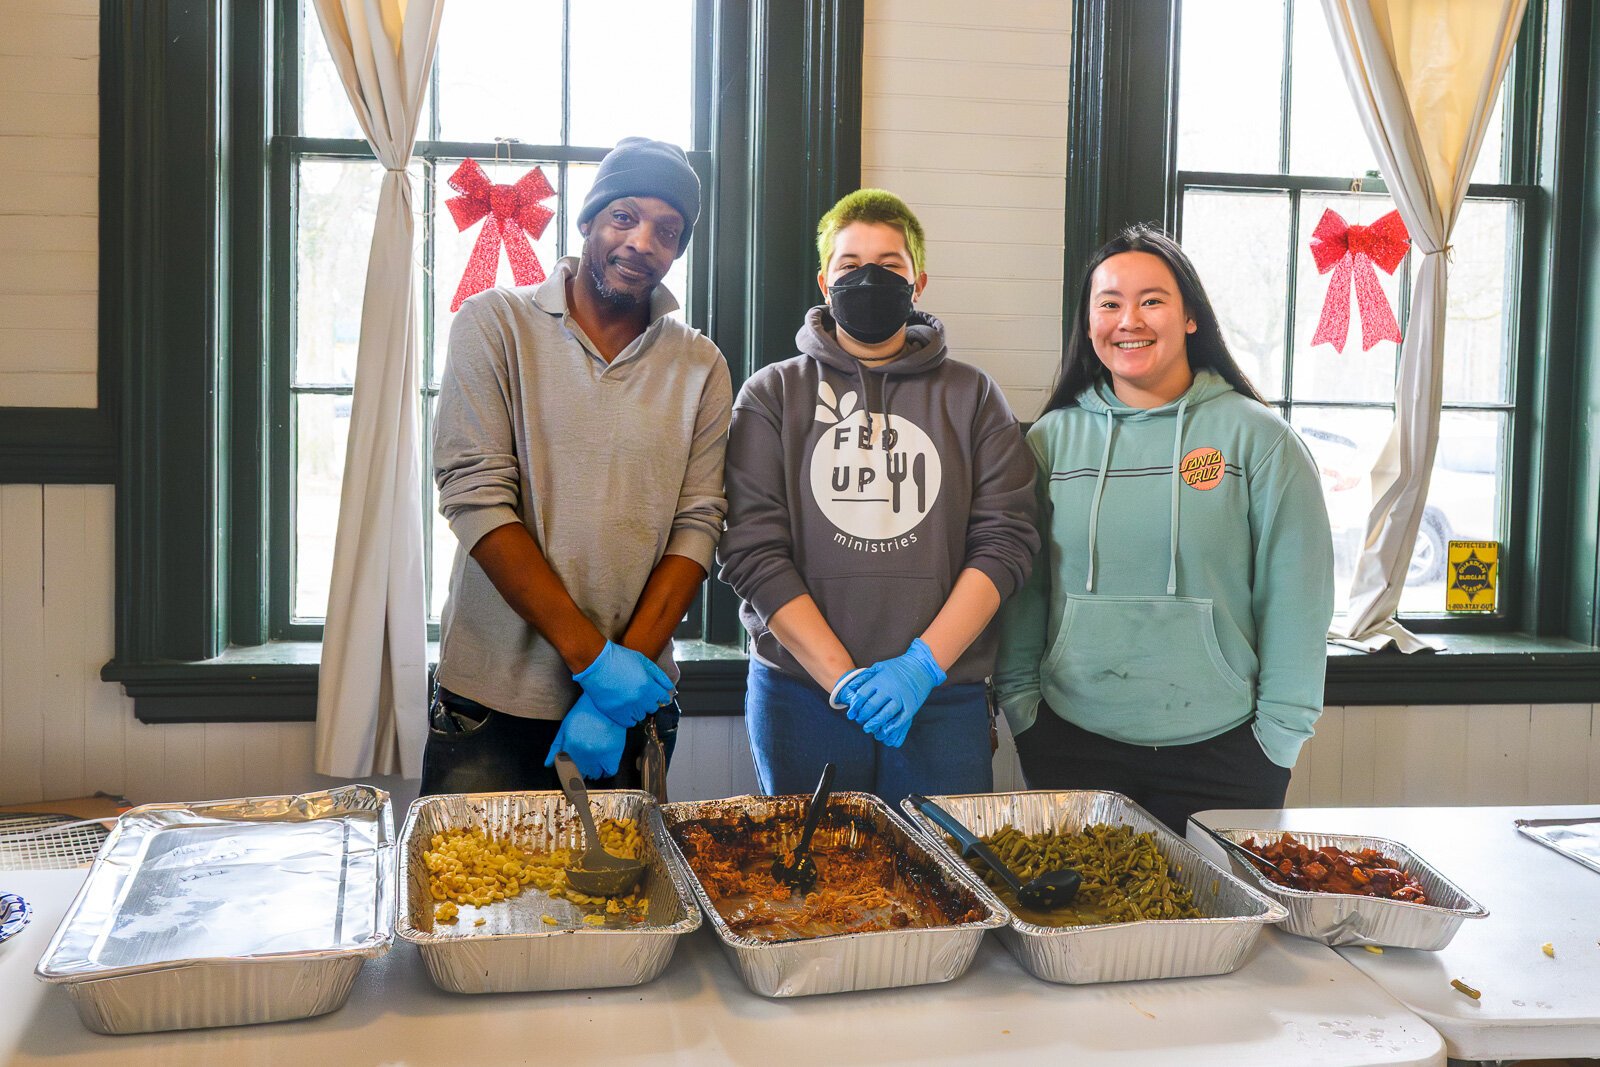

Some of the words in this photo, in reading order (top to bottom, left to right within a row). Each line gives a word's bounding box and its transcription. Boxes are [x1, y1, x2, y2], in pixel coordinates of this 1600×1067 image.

[833, 425, 899, 450] FED
[1179, 450, 1222, 473] SANTA
[831, 466, 876, 493] UP
[1186, 465, 1221, 485] CRUZ
[833, 531, 918, 553] ministries
[1459, 561, 1486, 573] GUARDIAN
[1462, 584, 1483, 592] ALARM
